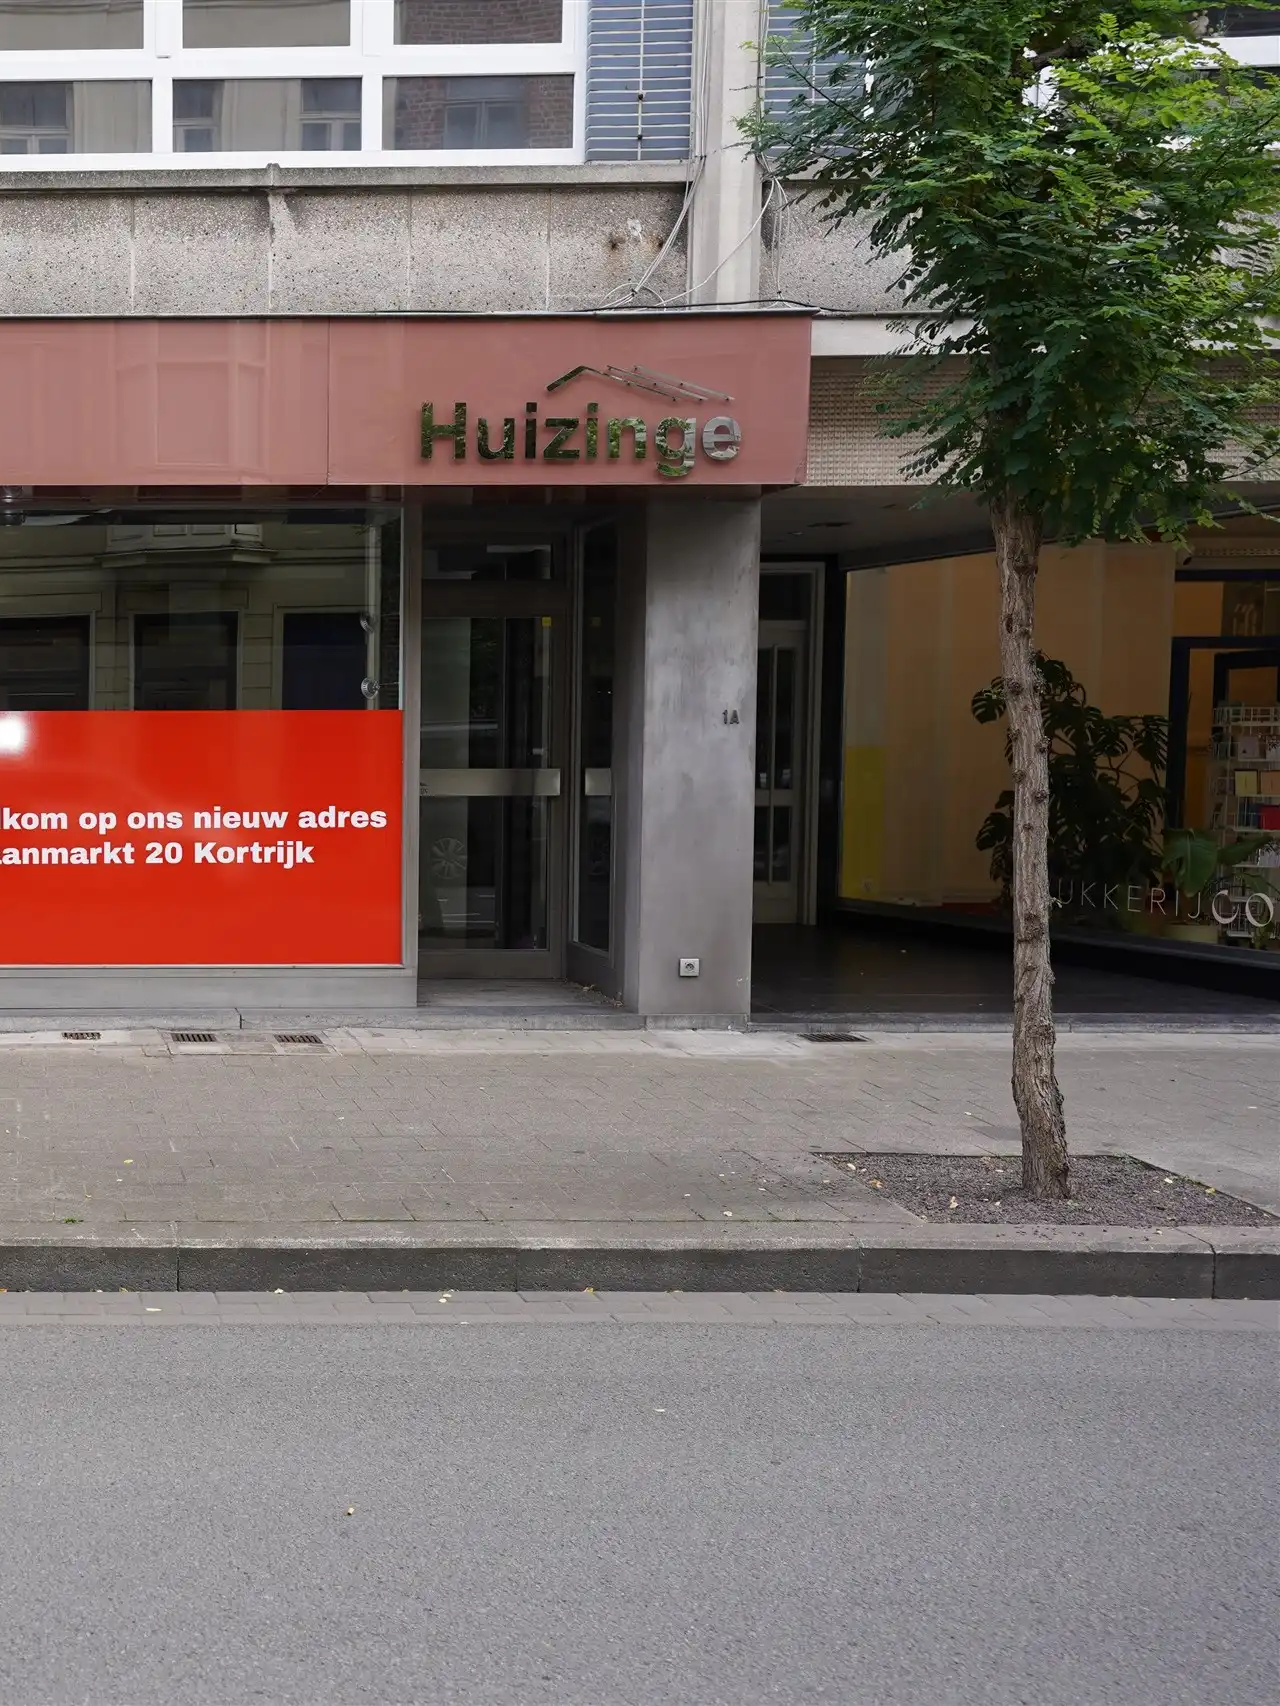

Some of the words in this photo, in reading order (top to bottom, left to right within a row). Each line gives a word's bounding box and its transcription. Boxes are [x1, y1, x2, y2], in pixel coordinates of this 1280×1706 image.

[420, 401, 742, 477] Huizinge
[722, 709, 739, 725] 1A
[78, 811, 117, 835] op
[127, 811, 184, 830] ons
[193, 806, 289, 829] nieuw
[298, 805, 387, 829] adres
[145, 841, 183, 864] 20
[194, 840, 315, 870] Kortrijk
